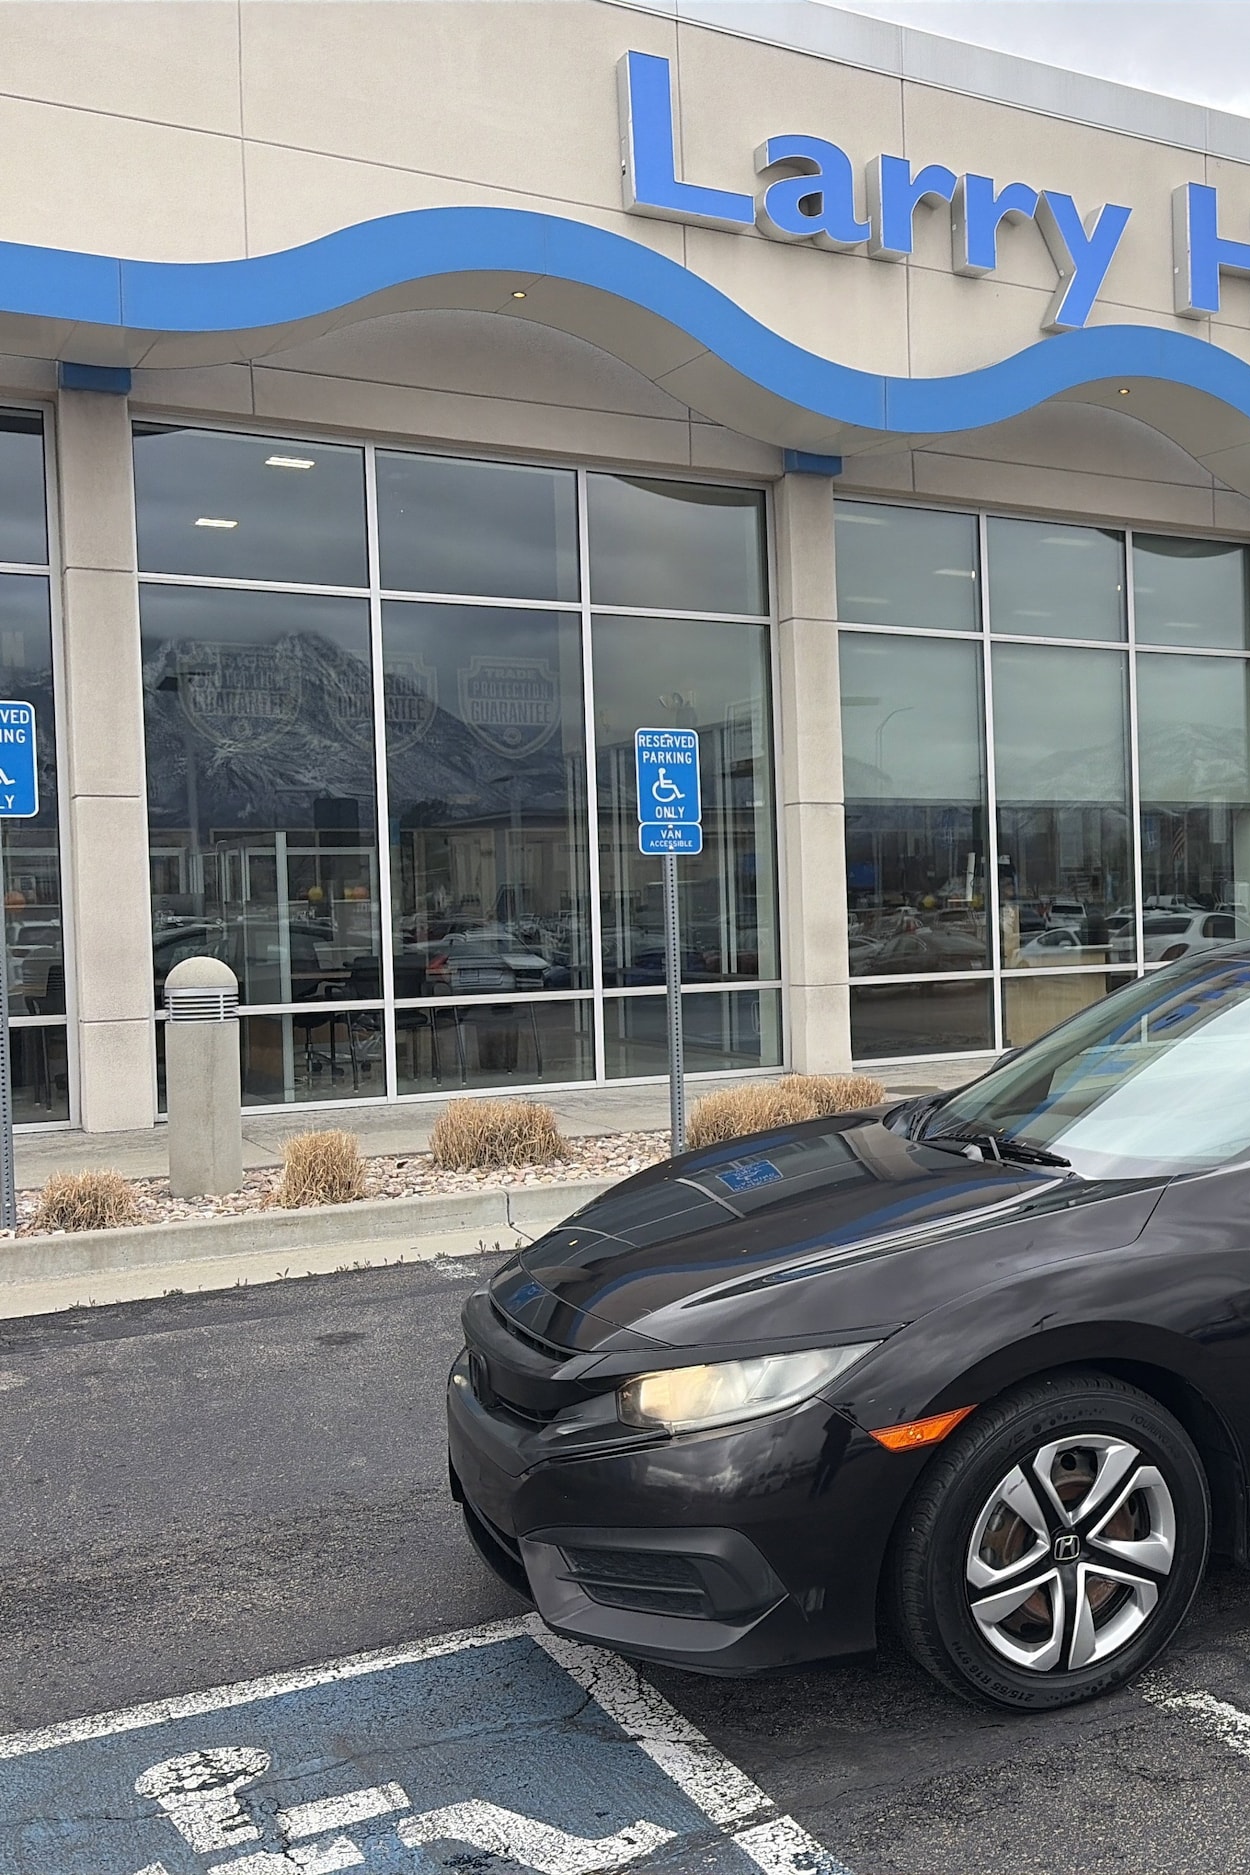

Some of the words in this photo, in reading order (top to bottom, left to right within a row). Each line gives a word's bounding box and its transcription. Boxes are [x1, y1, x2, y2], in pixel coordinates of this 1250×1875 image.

[620, 50, 1133, 329] Larry
[485, 667, 538, 680] TRADE
[472, 680, 549, 699] PROTECTION
[471, 699, 552, 723] GUARANTEE
[638, 734, 695, 749] RESERVED
[642, 751, 692, 765] PARKING
[655, 806, 685, 819] ONLY
[660, 829, 682, 840] VAN
[649, 840, 693, 848] ACCESSIBLE
